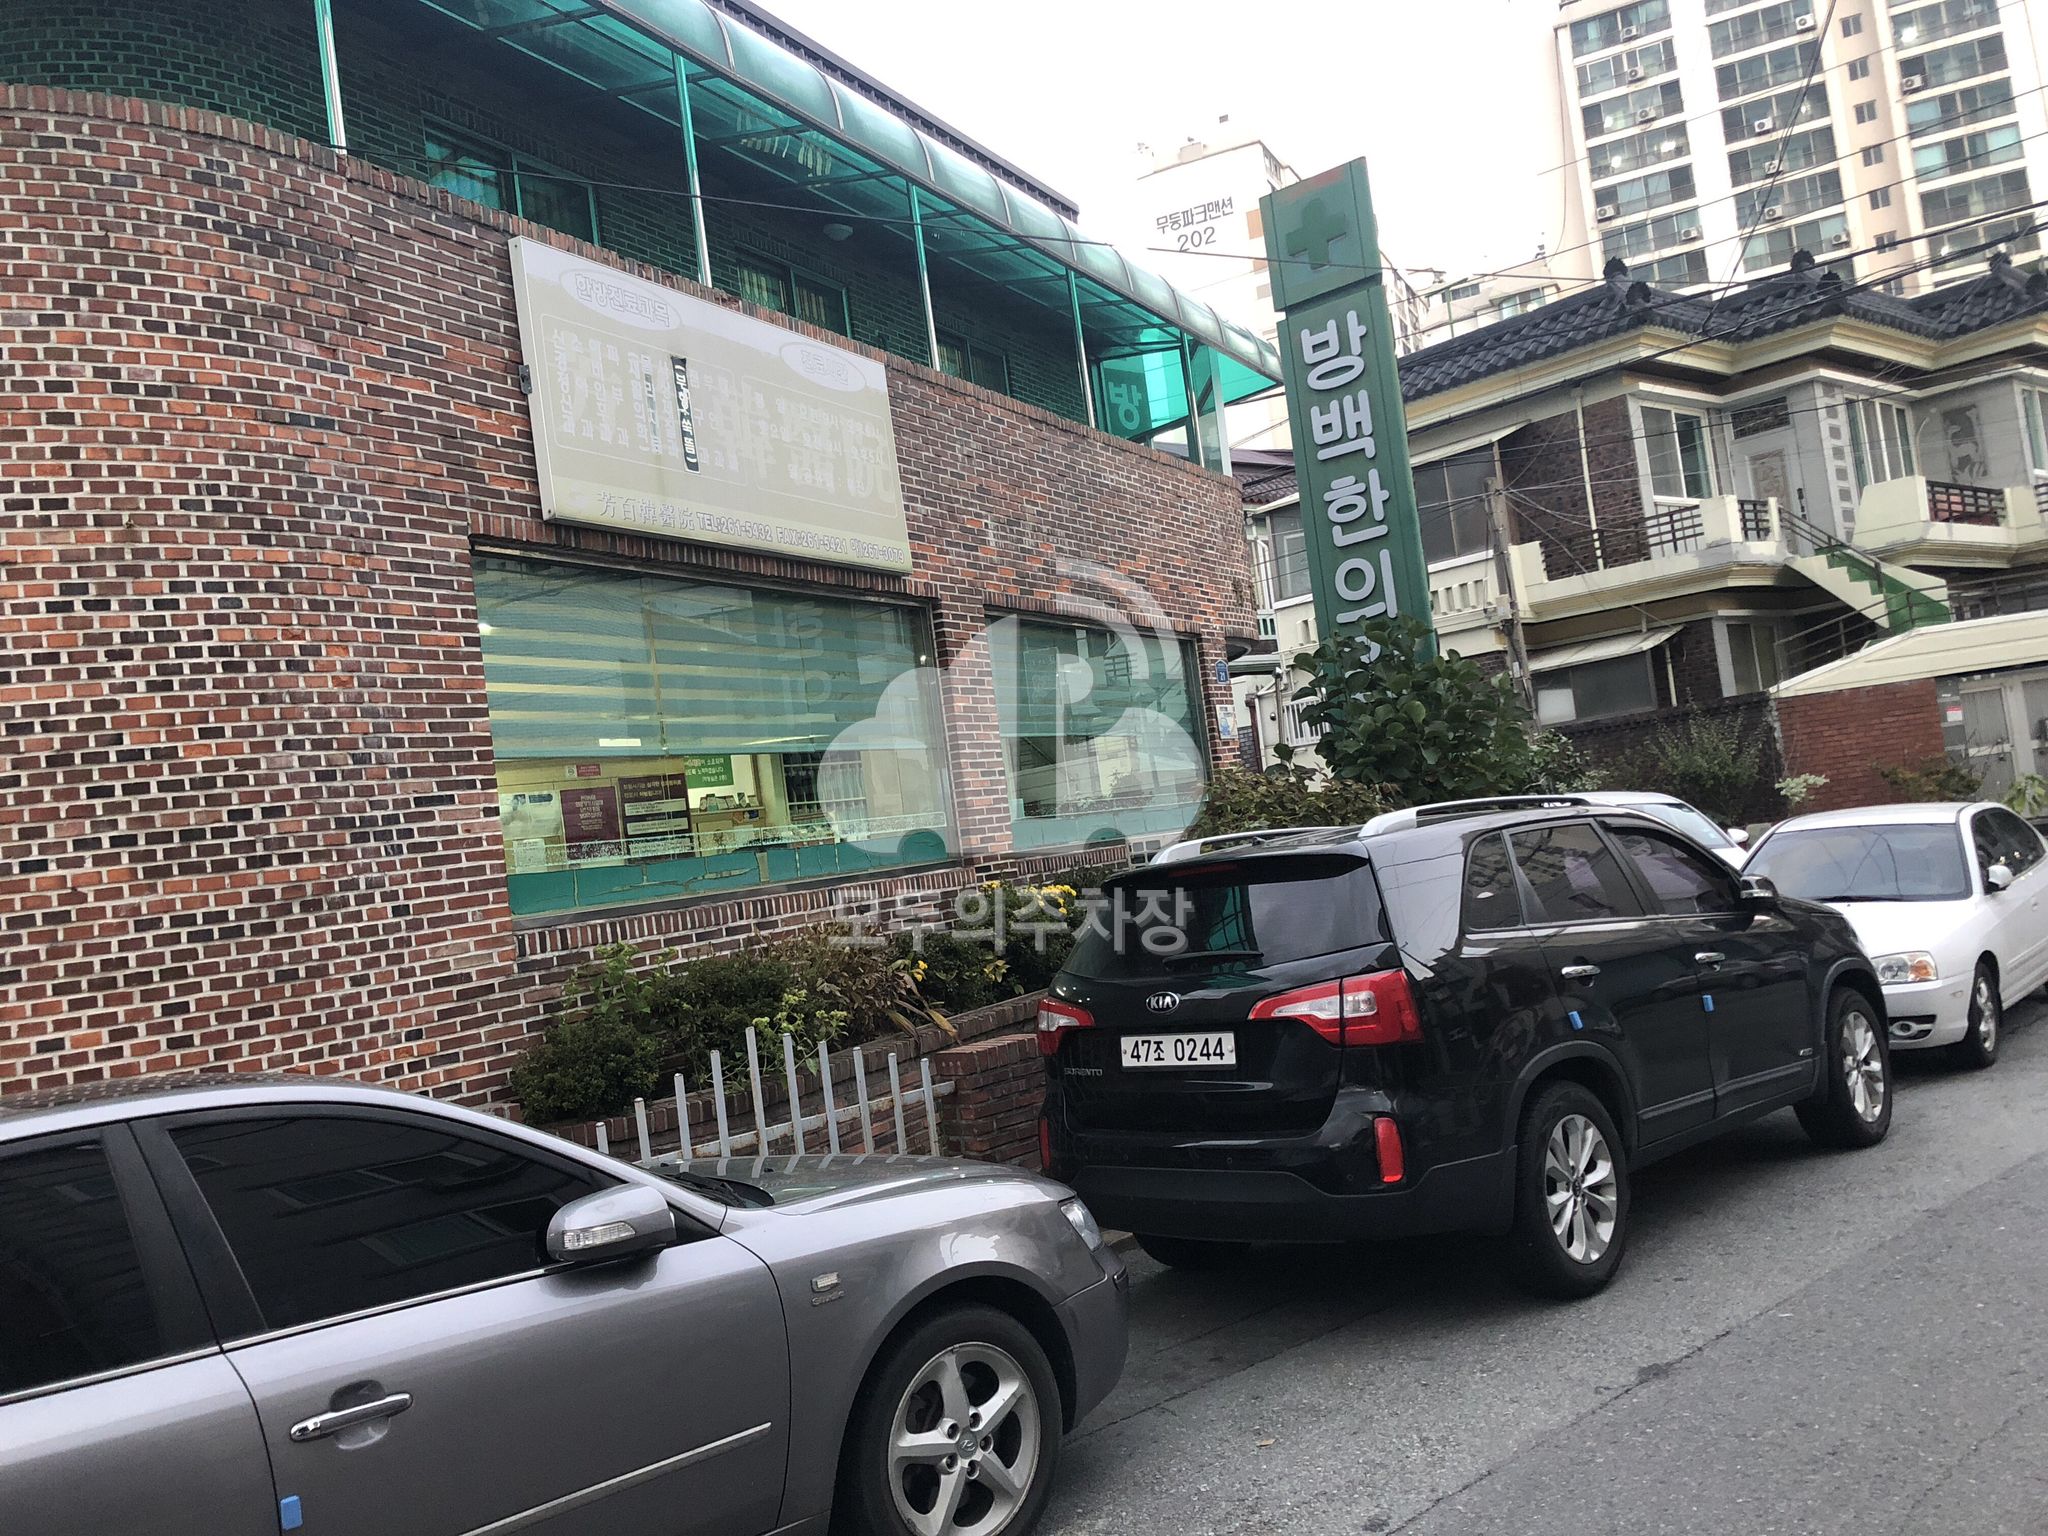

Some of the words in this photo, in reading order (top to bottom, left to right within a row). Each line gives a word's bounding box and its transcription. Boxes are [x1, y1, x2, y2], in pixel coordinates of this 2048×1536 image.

[1156, 196, 1234, 234] 무등파크맨션
[1177, 226, 1217, 252] 202
[576, 274, 670, 328] 한방진료과목
[1301, 310, 1398, 668] 방백한의
[696, 510, 773, 542] TEL:261-5432
[775, 525, 847, 555] FAX:261-5421
[1150, 997, 1174, 1009] KIA
[1130, 1039, 1166, 1063] 47조
[1173, 1037, 1225, 1062] 0244
